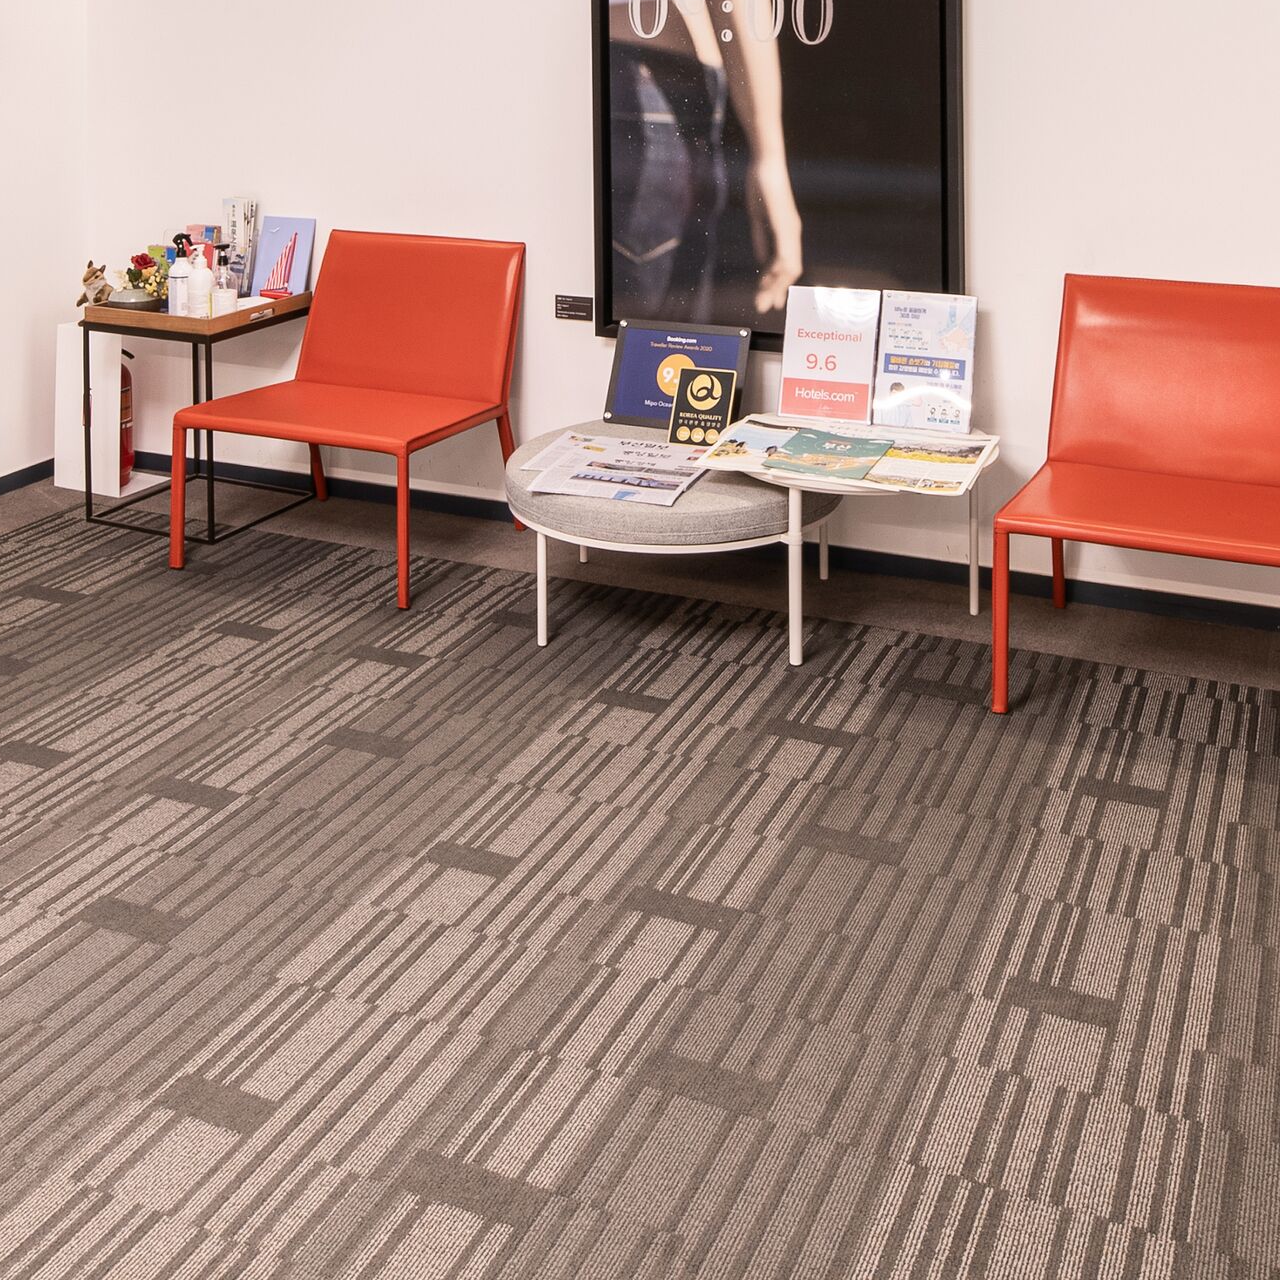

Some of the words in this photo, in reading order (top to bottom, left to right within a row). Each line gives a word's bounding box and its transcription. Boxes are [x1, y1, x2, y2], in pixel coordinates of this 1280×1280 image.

[666, 335, 697, 344] Booking.com
[797, 328, 862, 343] Exceptional
[806, 353, 837, 371] 9.6
[662, 367, 680, 383] 9.
[795, 386, 855, 403] Hotels.com
[644, 399, 658, 407] Mipo
[679, 411, 698, 419] KOREA
[697, 413, 723, 421] QUALITY
